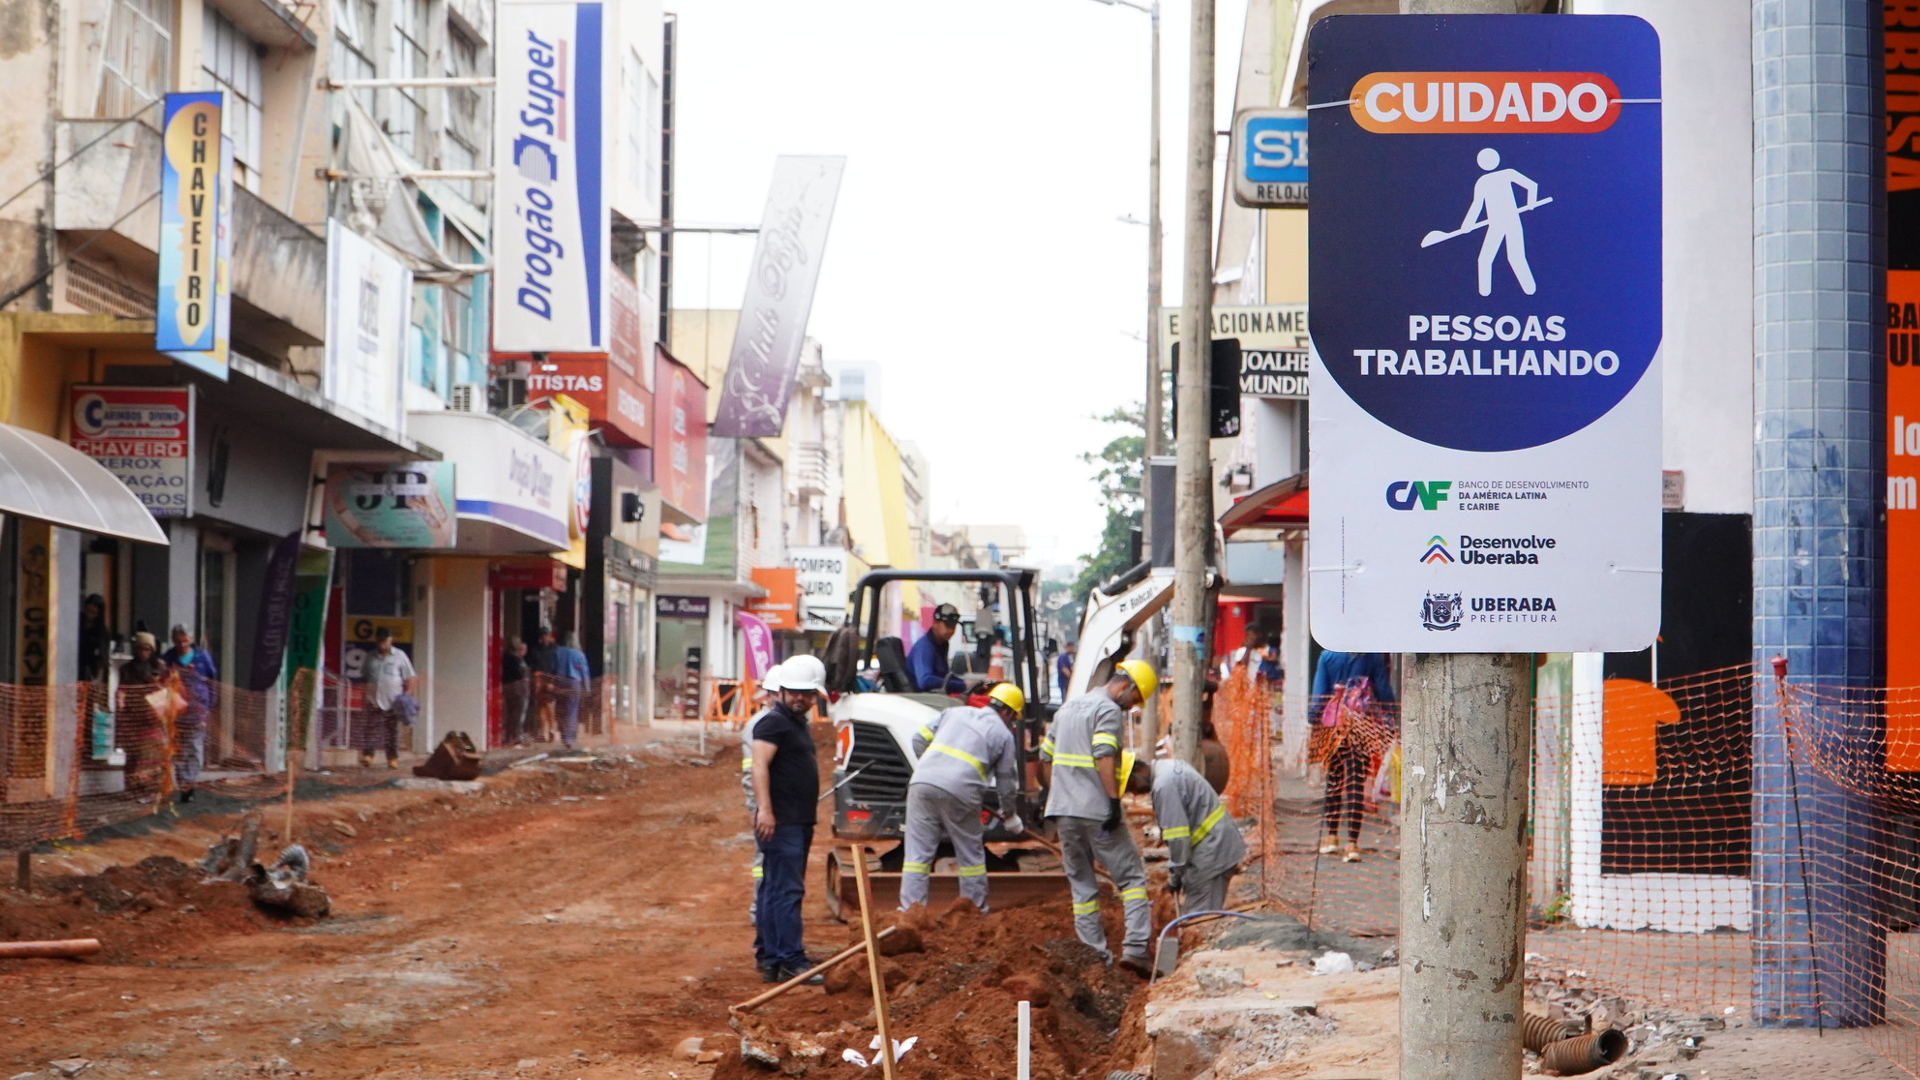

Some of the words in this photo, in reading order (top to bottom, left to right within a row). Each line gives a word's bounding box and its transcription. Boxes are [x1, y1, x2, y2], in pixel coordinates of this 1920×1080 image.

[520, 29, 566, 136] Super
[1364, 82, 1609, 123] CUIDADO
[186, 112, 208, 327] CHAVEIRO
[516, 188, 563, 320] Drogão
[1887, 302, 1920, 330] BA
[1409, 314, 1567, 342] PESSOAS
[1353, 349, 1620, 376] TRABALHANDO
[76, 441, 183, 457] CHAVEIRO
[1458, 480, 1490, 489] BANCO
[1491, 480, 1503, 489] DE
[1505, 480, 1589, 490] DESENVOLVIMENTO
[135, 493, 186, 506] BOS
[1385, 480, 1453, 511] CAF
[1458, 491, 1471, 500] DA
[1472, 489, 1513, 500] AMÉRICA
[1515, 491, 1548, 500] LATINA
[1459, 503, 1465, 511] E
[1467, 503, 1500, 511] CARIBE
[1460, 535, 1557, 549] Desenvolve
[792, 557, 842, 574] COMPRO
[1460, 550, 1539, 565] Uberaba
[805, 580, 834, 596] URO
[1471, 597, 1557, 612] UBERABA
[1471, 614, 1557, 623] PREFEITURA
